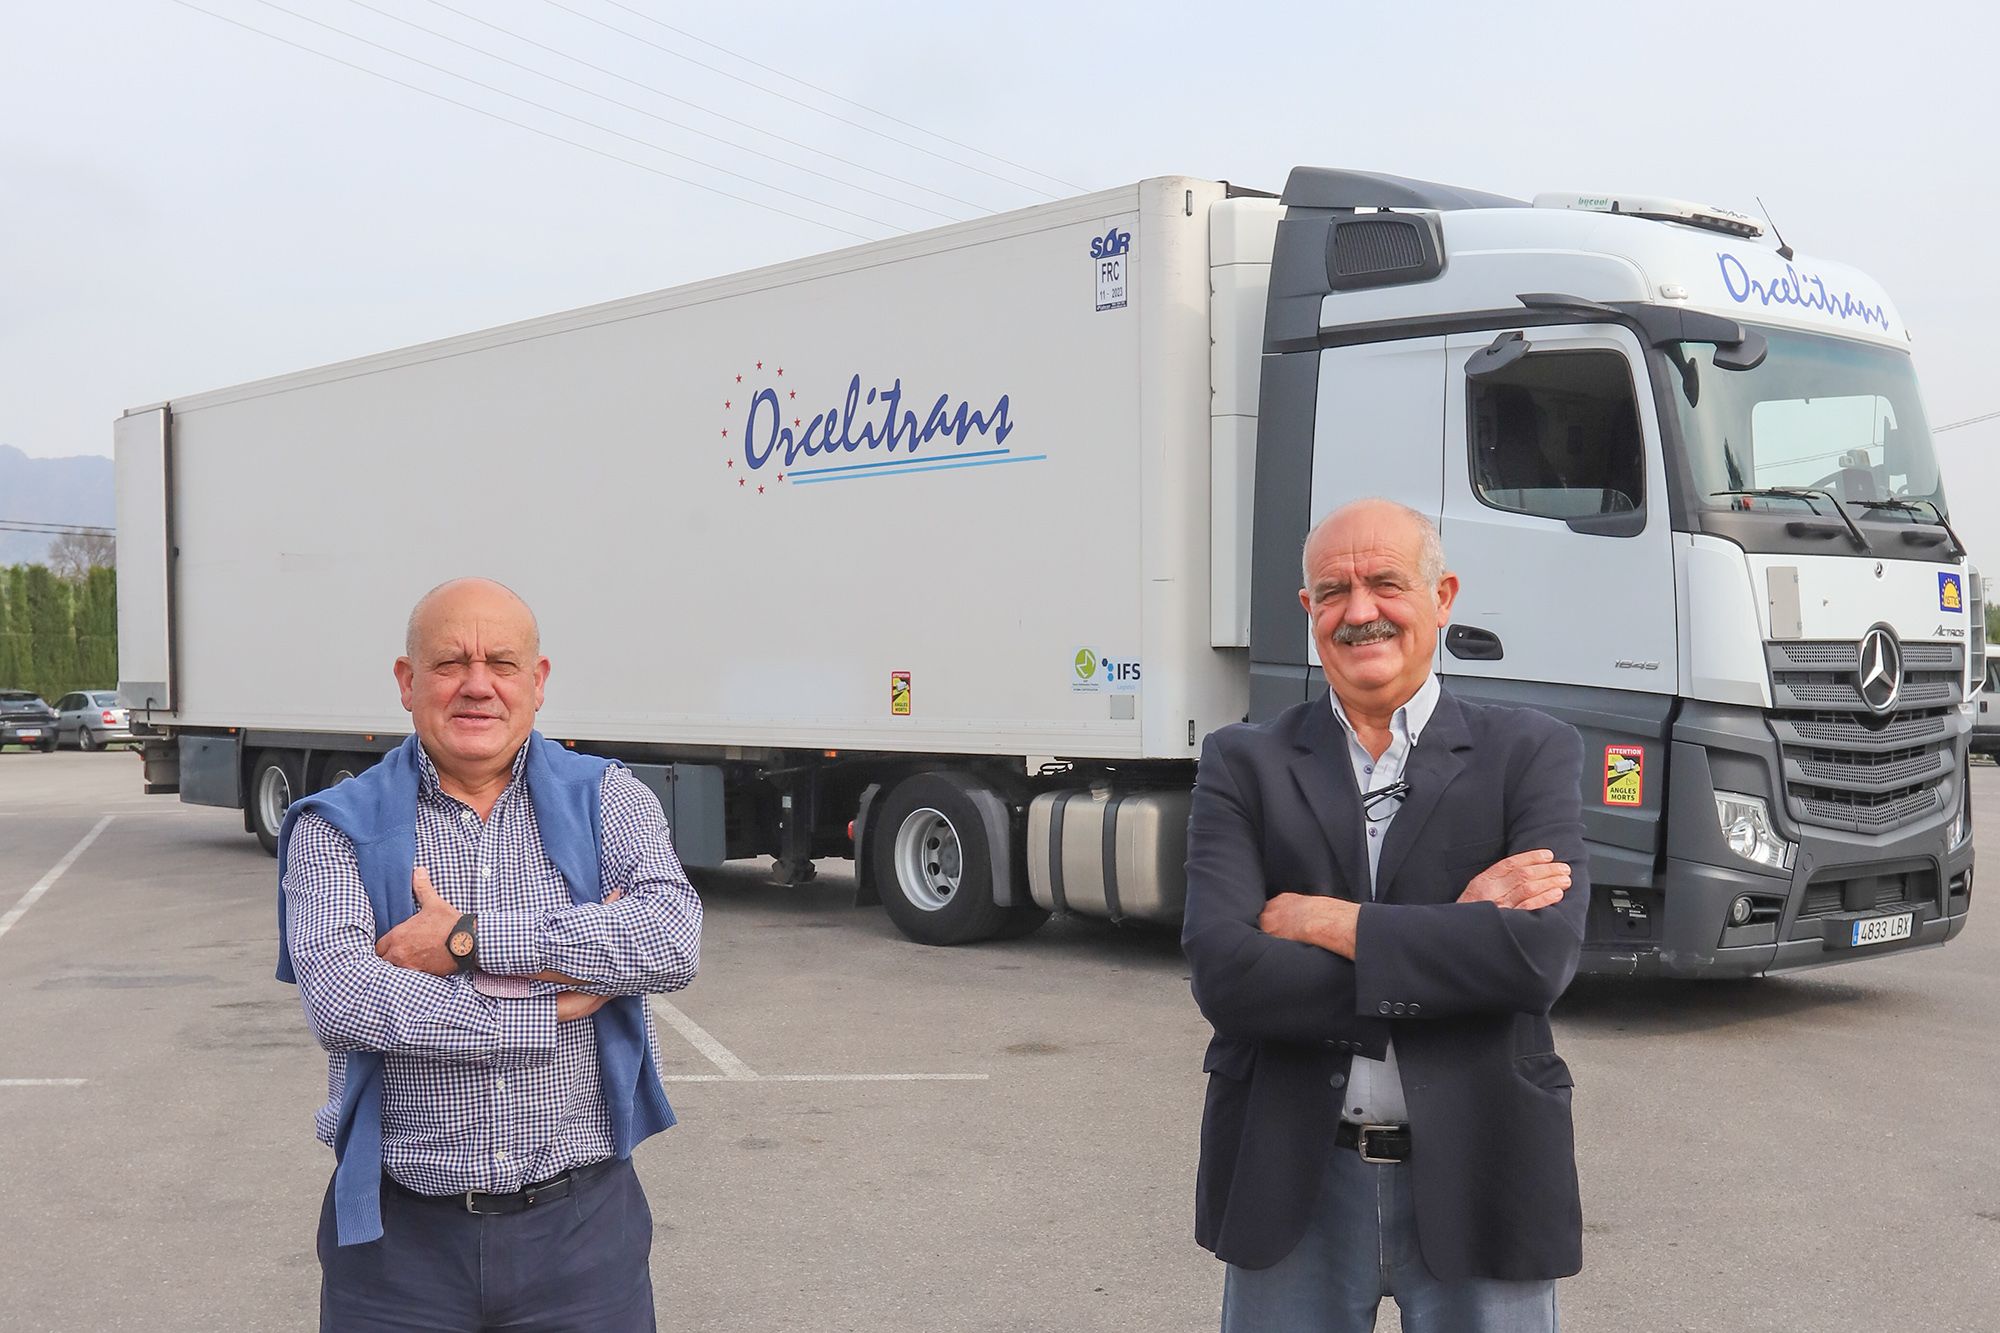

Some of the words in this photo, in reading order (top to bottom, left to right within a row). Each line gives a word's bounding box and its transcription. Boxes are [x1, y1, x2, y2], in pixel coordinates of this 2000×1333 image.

[1101, 260, 1120, 283] FRC
[1112, 287, 1123, 298] 2023
[1716, 252, 1889, 332] Orcelitrans
[745, 373, 1013, 470] Orcelitrans
[1117, 663, 1141, 680] IFS
[1608, 748, 1642, 756] ATTENTION
[1610, 787, 1637, 795] ANGLES
[1861, 920, 1887, 941] 4833
[1890, 917, 1910, 937] LBX
